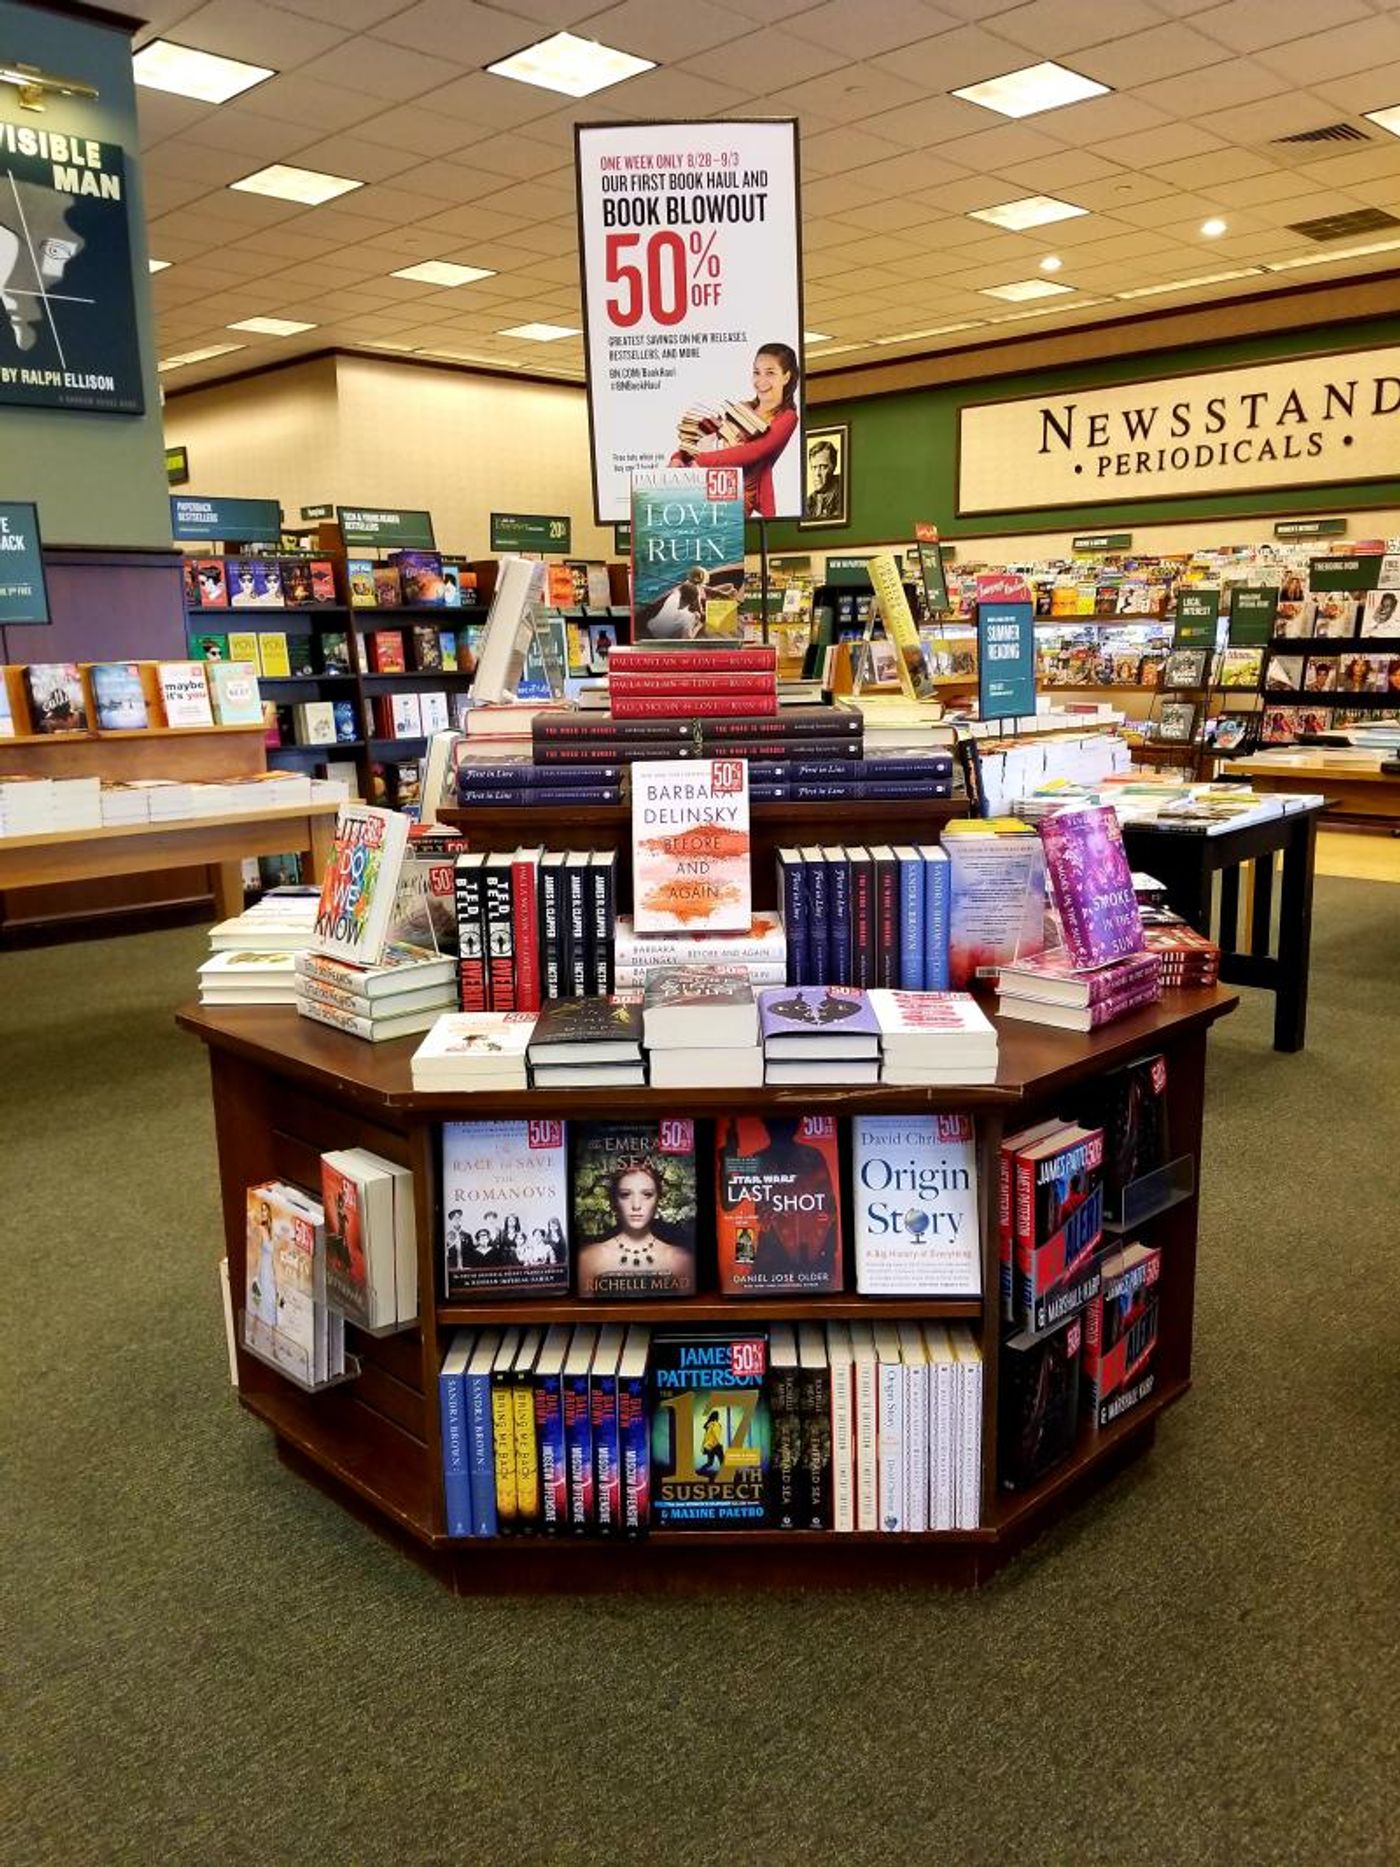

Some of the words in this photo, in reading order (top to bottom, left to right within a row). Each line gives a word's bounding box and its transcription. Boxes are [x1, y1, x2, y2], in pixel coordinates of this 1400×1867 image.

[0, 123, 101, 169] ISIBLE
[600, 156, 622, 170] ONE
[624, 155, 653, 170] WEEK
[656, 154, 683, 169] ONLY
[53, 164, 120, 200] MAN
[602, 175, 627, 192] OUR
[631, 173, 666, 191] FIRST
[670, 172, 703, 190] BOOK
[707, 171, 739, 188] HAUL
[742, 170, 768, 187] AND
[603, 197, 660, 227] BOOK
[667, 193, 767, 224] BLOWOUT
[692, 283, 722, 307] OFF
[609, 336, 644, 346] GREATEST
[646, 334, 678, 345] SAVINGS
[680, 333, 691, 343] ON
[692, 332, 708, 343] NEW
[662, 348, 677, 359] AND
[2, 368, 17, 382] BY
[21, 369, 61, 386] RALPH
[64, 373, 115, 391] ELLISON
[1097, 432, 1323, 477] PERIODICALS
[646, 503, 727, 527] LOVE
[648, 538, 726, 561] RUIN
[987, 624, 1020, 641] SUMMER
[988, 643, 1020, 660] READING
[165, 681, 204, 692] maybe
[166, 692, 183, 700] it's
[644, 806, 738, 824] DELINSKY
[664, 837, 721, 850] BEFORE
[339, 849, 365, 878] DO
[676, 861, 710, 874] AND
[545, 875, 554, 898] JAMES
[670, 887, 719, 899] AGAIN
[457, 878, 468, 921] BELL
[467, 883, 478, 914] TED
[487, 877, 499, 919] BELL
[497, 883, 509, 913] TED
[1093, 889, 1130, 912] SMOKE
[314, 910, 363, 946] KNOW
[1113, 936, 1133, 953] SUN
[862, 1133, 901, 1145] David
[453, 1157, 492, 1172] RACE
[517, 1155, 556, 1169] SAVE
[616, 1154, 655, 1170] SEA
[728, 1175, 762, 1185] STAR
[762, 1175, 797, 1184] WARS
[861, 1159, 970, 1200] Origin
[454, 1186, 557, 1202] ROMANOVS
[728, 1184, 772, 1202] LAST
[773, 1194, 825, 1211] SHOT
[587, 1278, 648, 1292] RICHELLE
[733, 1274, 768, 1284] DANIEL
[798, 1272, 830, 1282] OLDER
[1048, 1286, 1082, 1321] MARSHALL
[657, 1369, 763, 1388] PATTERSON
[660, 1389, 759, 1483] 17
[662, 1484, 764, 1501] SUSPECT
[671, 1508, 715, 1518] MAXINE
[719, 1507, 764, 1518] PAETRO
